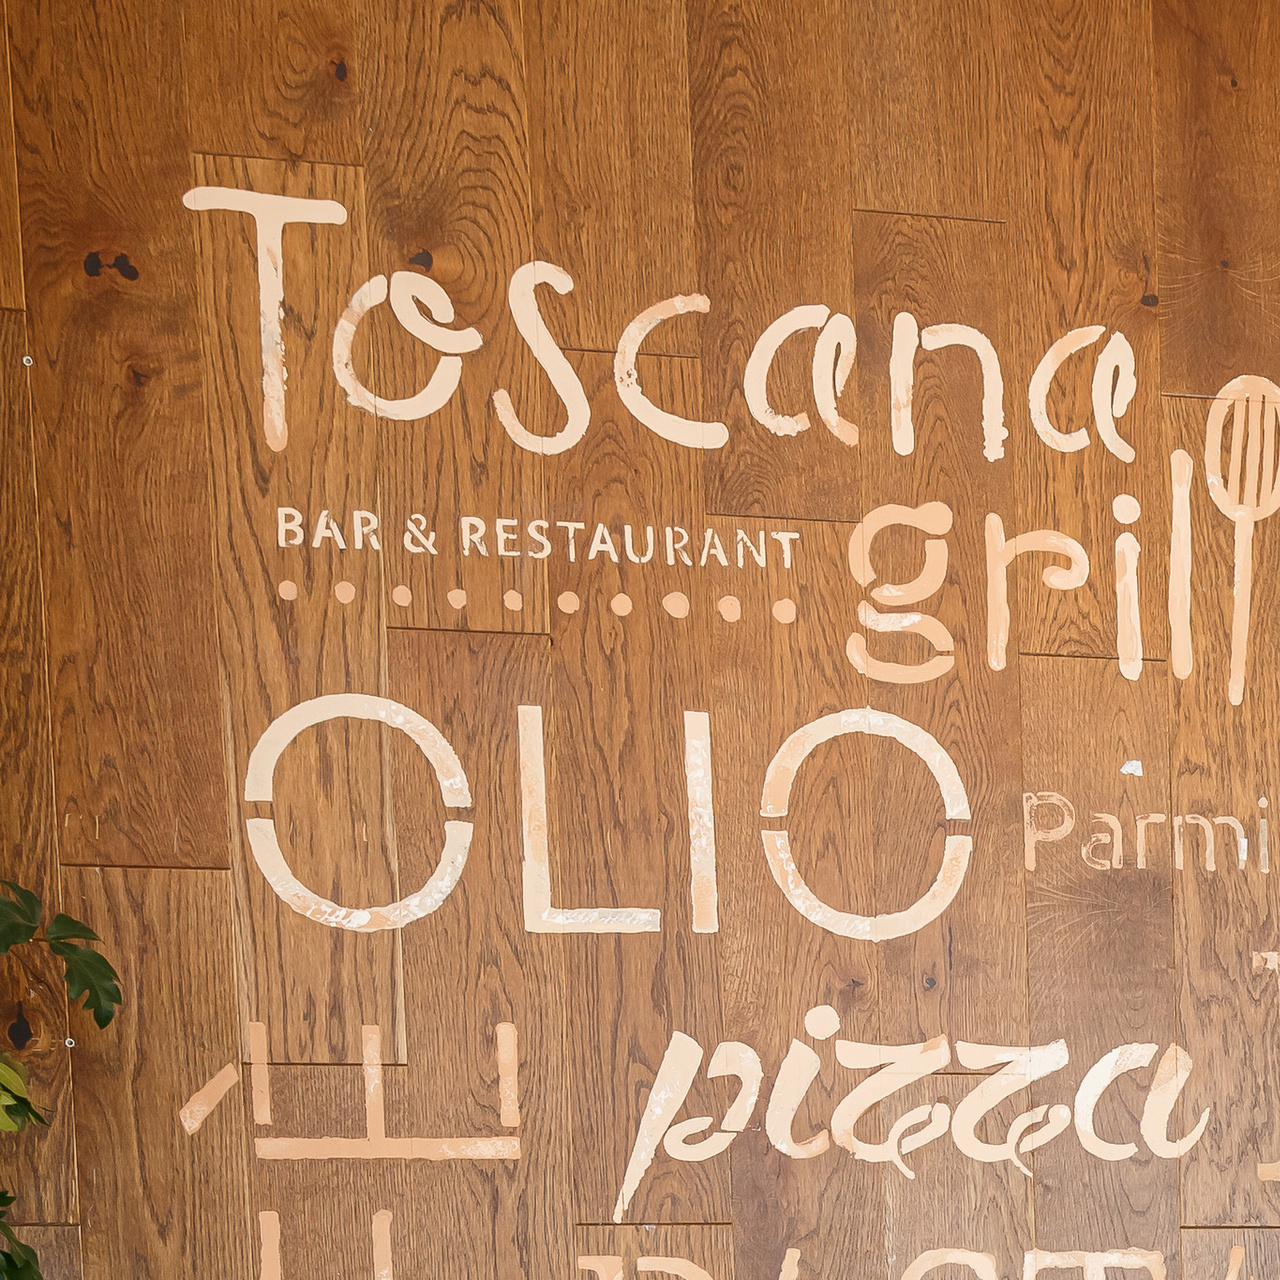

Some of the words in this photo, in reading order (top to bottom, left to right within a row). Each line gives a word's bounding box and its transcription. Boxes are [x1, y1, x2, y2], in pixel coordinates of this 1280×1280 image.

[183, 186, 1135, 462] Toscana
[276, 506, 381, 552] BAR
[402, 513, 438, 554] &
[462, 517, 800, 569] RESTAURANT
[245, 692, 973, 942] OLIO
[613, 1005, 1209, 1223] pizza
